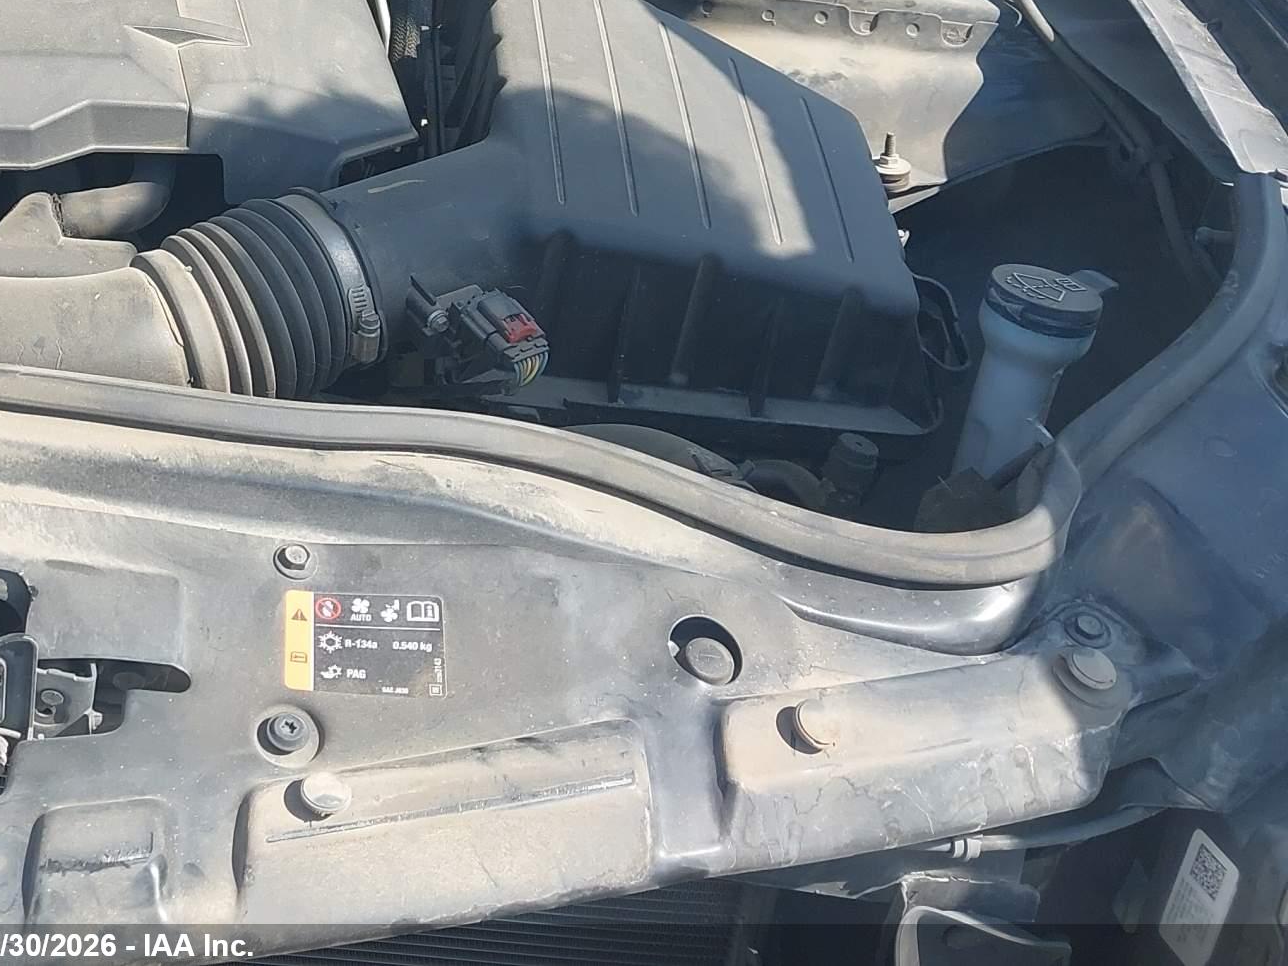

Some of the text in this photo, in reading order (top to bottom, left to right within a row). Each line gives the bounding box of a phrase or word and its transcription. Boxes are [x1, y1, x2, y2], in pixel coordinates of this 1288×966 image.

[350, 614, 372, 622] AUTO
[344, 638, 433, 653] R-134a 0.540 kg
[346, 668, 367, 680] PAG
